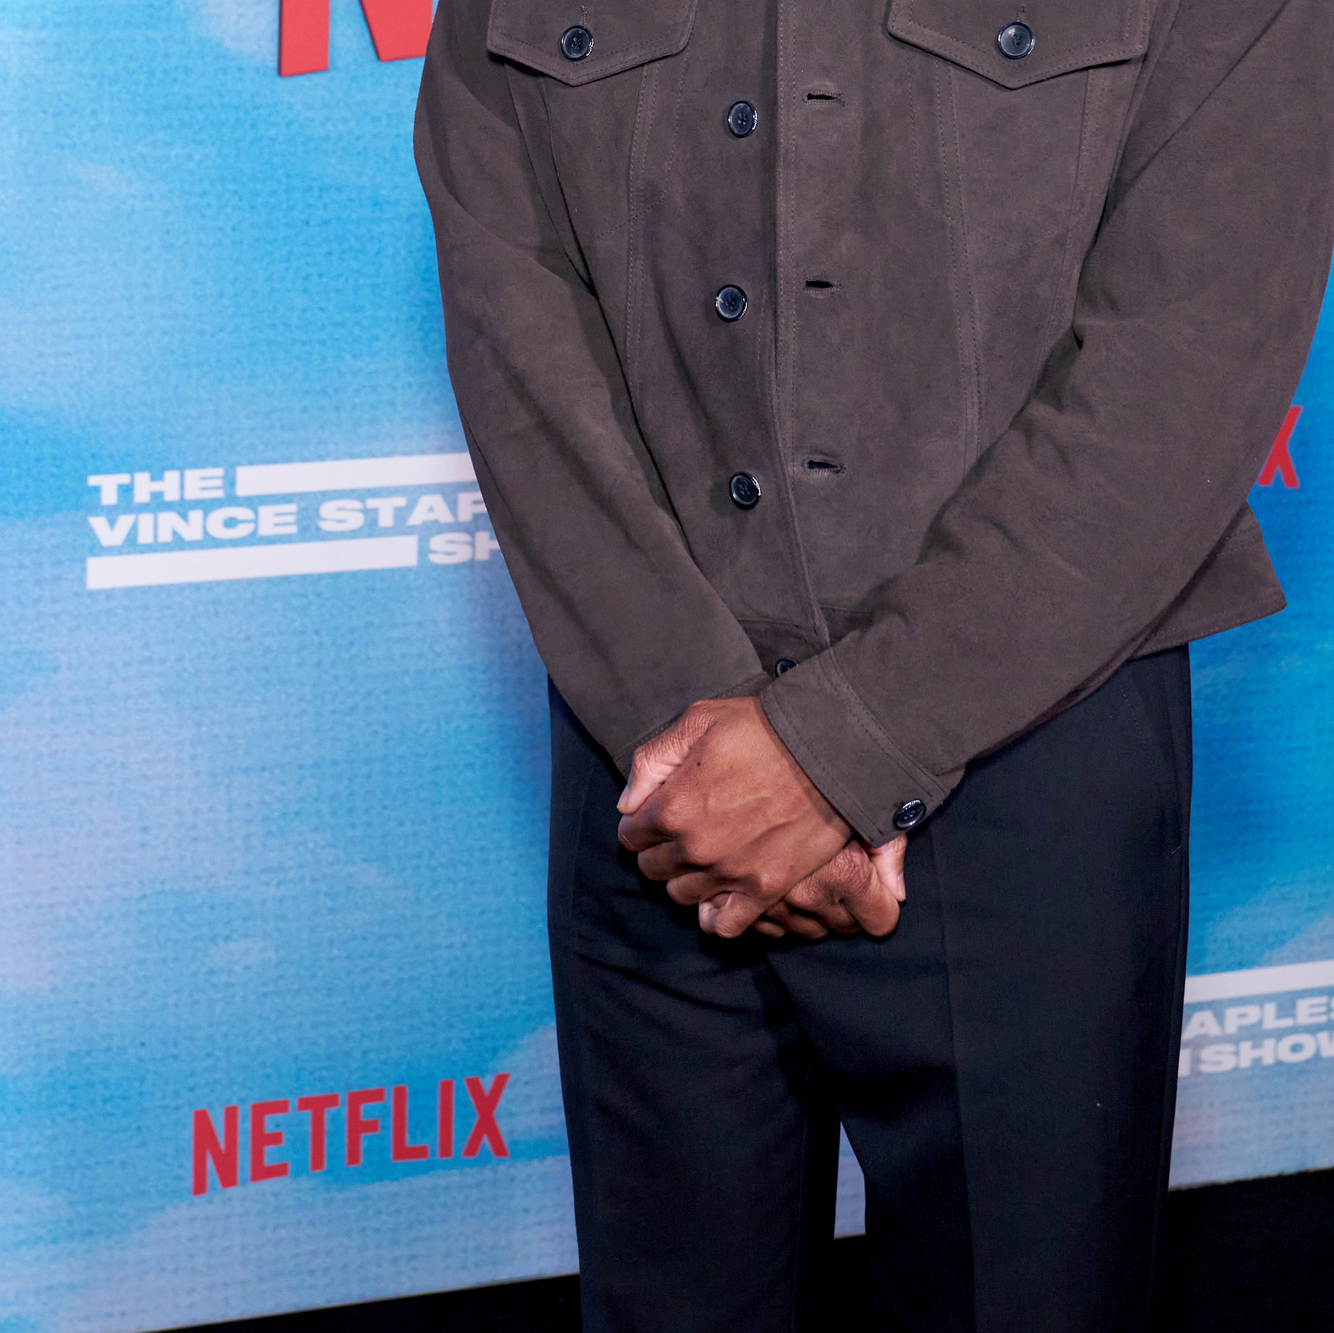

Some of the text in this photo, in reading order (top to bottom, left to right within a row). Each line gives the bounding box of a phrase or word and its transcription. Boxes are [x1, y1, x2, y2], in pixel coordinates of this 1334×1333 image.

[87, 466, 226, 506] THE
[87, 491, 488, 547] VINCE STAP
[193, 1073, 510, 1196] NETFLIX
